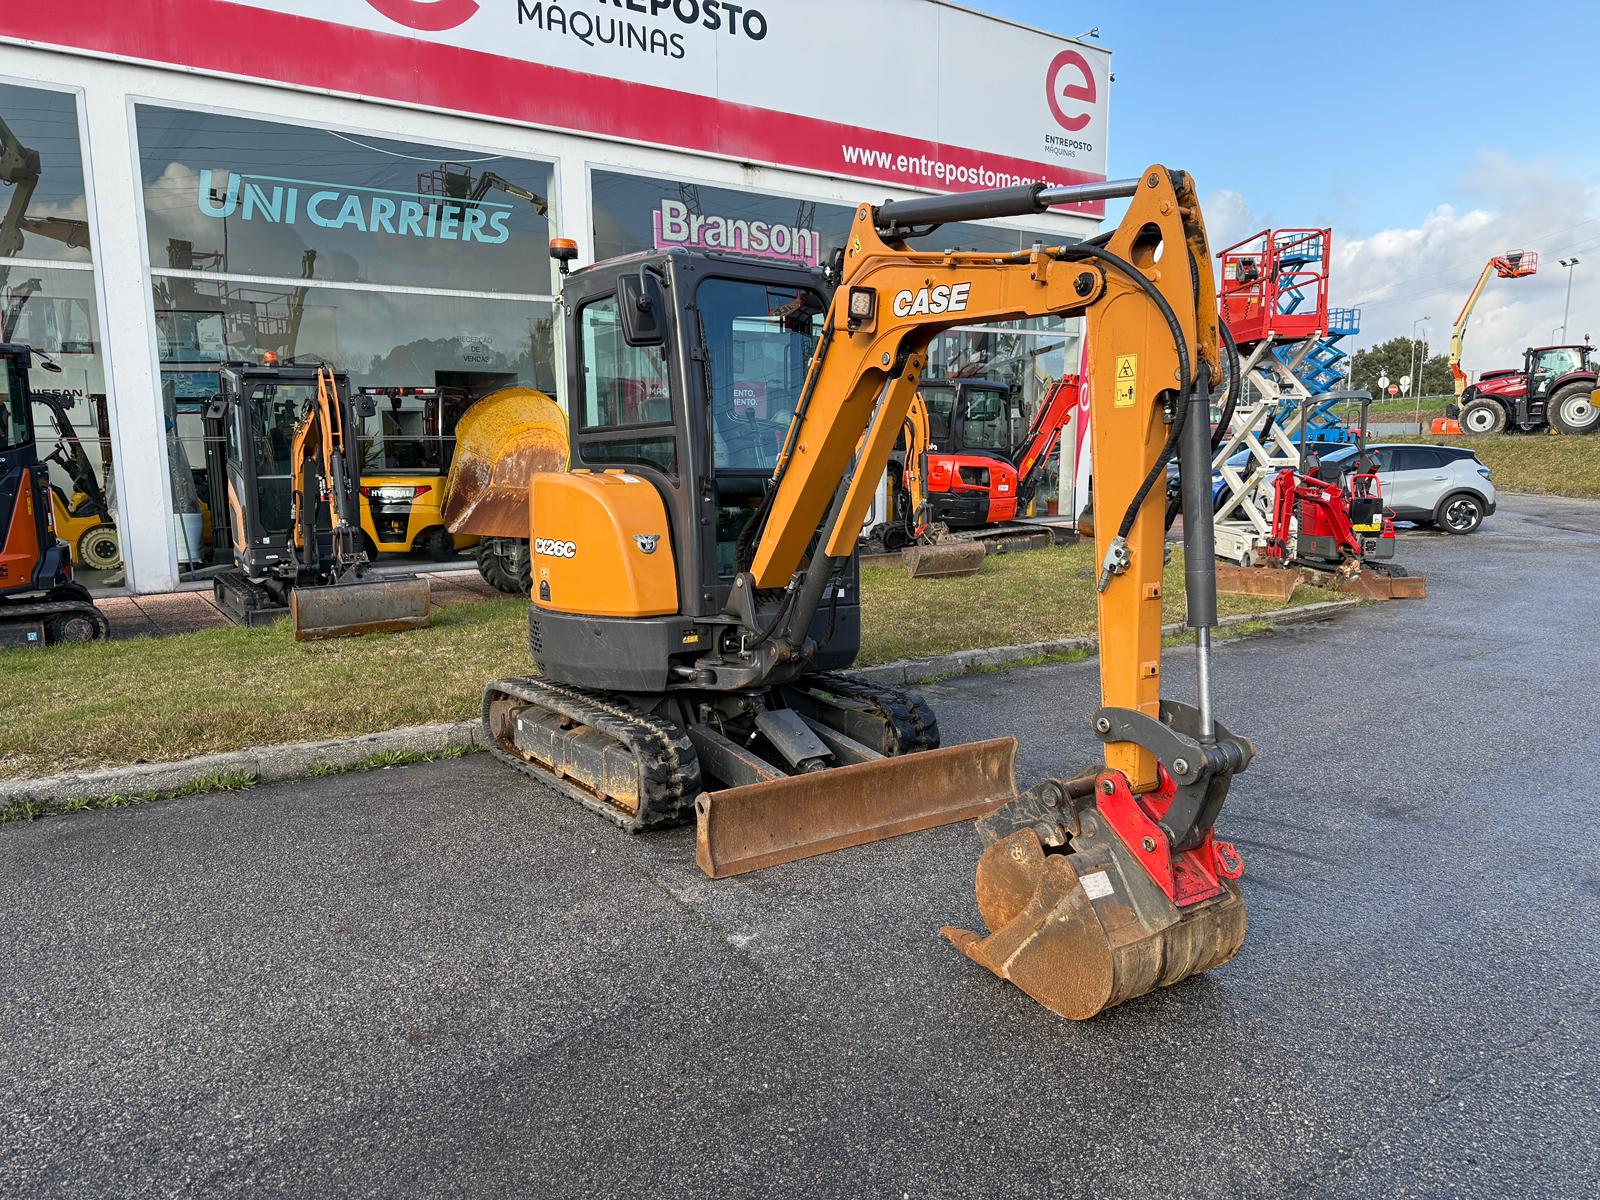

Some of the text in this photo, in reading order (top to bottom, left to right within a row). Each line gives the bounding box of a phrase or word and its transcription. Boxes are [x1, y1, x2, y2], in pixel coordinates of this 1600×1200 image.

[1045, 134, 1093, 152] ENTREPOSTO
[660, 199, 813, 257] Branson
[893, 282, 971, 317] CASE
[535, 537, 576, 559] CX26C
